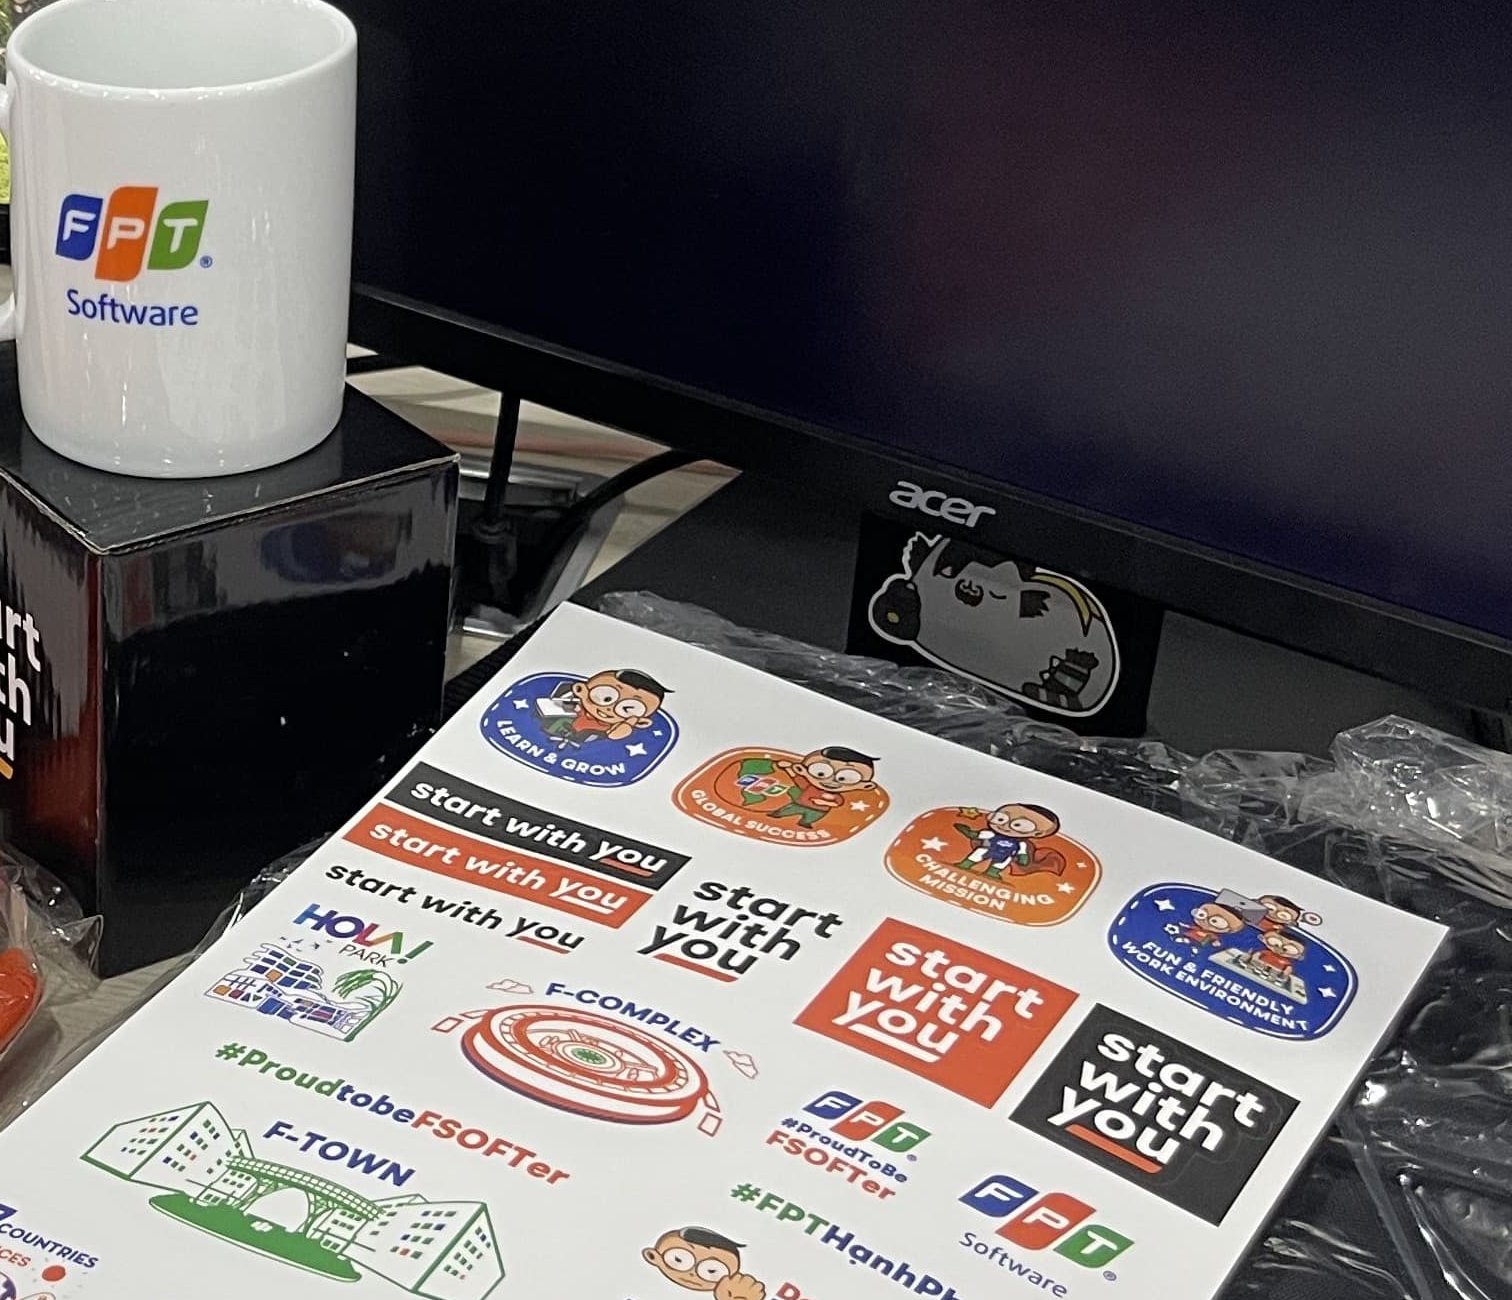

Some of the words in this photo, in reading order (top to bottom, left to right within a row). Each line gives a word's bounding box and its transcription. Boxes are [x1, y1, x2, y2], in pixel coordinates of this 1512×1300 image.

[58, 198, 204, 267] FPT
[66, 288, 199, 326] Software
[889, 481, 996, 527] acer
[496, 719, 540, 761] LEARN
[545, 751, 557, 765] &
[561, 758, 626, 777] GROW
[411, 781, 503, 827] start
[505, 815, 587, 853] with
[589, 840, 669, 874] you
[691, 789, 742, 827] GLOBAL
[745, 819, 830, 841] SUCCESS
[369, 822, 464, 865] start
[464, 854, 547, 891] with
[548, 878, 628, 911] you
[915, 853, 1055, 905] CHALLENGING
[919, 874, 1006, 911] MISSION
[325, 864, 419, 905] start
[422, 896, 507, 930] with
[506, 916, 586, 950] you
[673, 905, 801, 961] with
[693, 882, 843, 938] start
[338, 944, 396, 968] PARK
[636, 925, 759, 975] you
[885, 941, 1044, 1020] start
[1142, 941, 1182, 965] FUN
[1183, 961, 1197, 974] &
[1200, 970, 1294, 1015] FRIENDLY
[545, 982, 722, 1053] F-COMPLEX
[866, 967, 1004, 1042] with
[1122, 941, 1174, 975] WORK
[1176, 970, 1308, 1031] ENVIRONMENT
[831, 991, 961, 1055] you
[215, 1042, 571, 1185] #ProudtobeFSOFTer
[1079, 1060, 1224, 1152] with
[1096, 1033, 1266, 1128] start
[262, 1120, 416, 1186] F-TOWN
[781, 1117, 908, 1184] #ProudToBe
[808, 1094, 926, 1147] FPT
[1047, 1085, 1182, 1165] you
[765, 1130, 896, 1200] FSOFTer
[965, 1178, 1127, 1261] FPT
[959, 1231, 1069, 1299] Software
